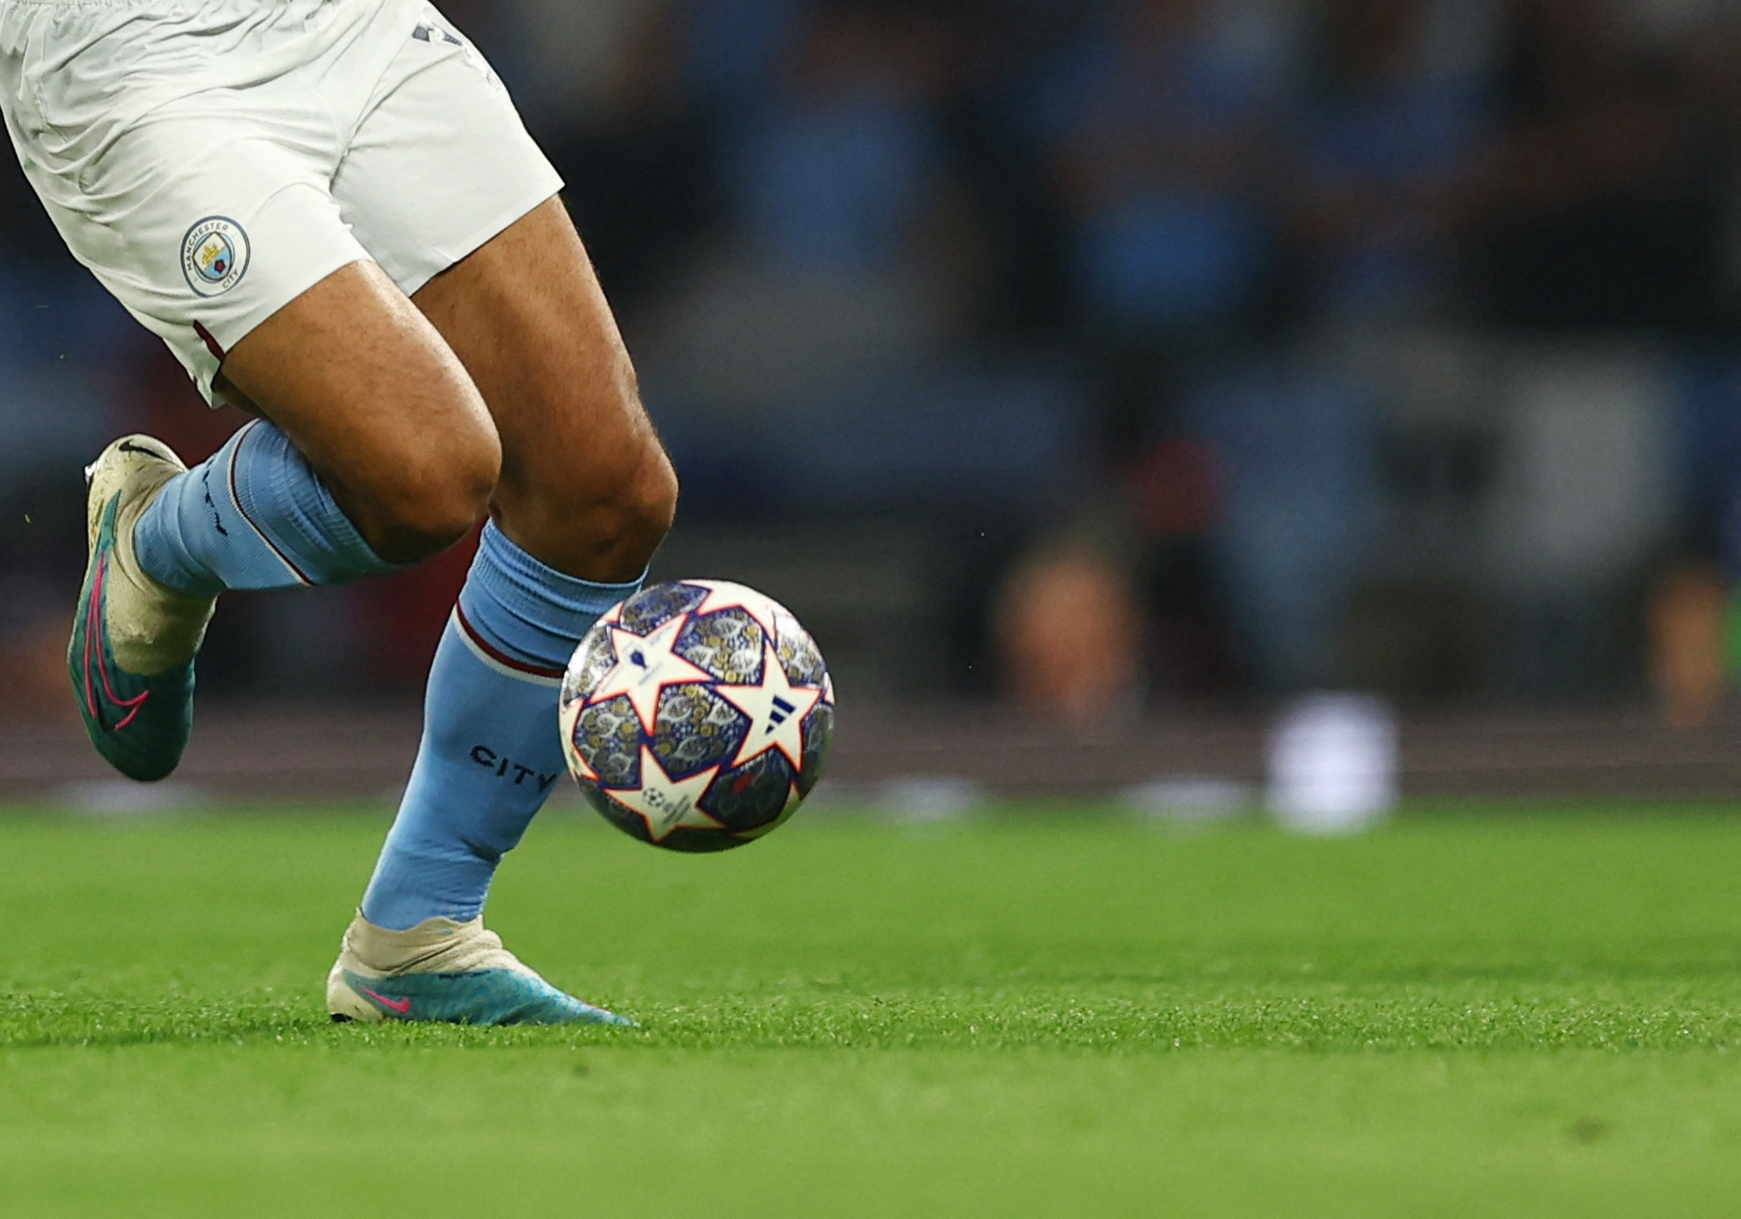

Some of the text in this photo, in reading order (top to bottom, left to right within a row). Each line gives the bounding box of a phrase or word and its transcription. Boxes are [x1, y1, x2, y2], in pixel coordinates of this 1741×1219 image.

[186, 222, 239, 289] MANCHESTER CITY
[469, 745, 557, 793] CITY
